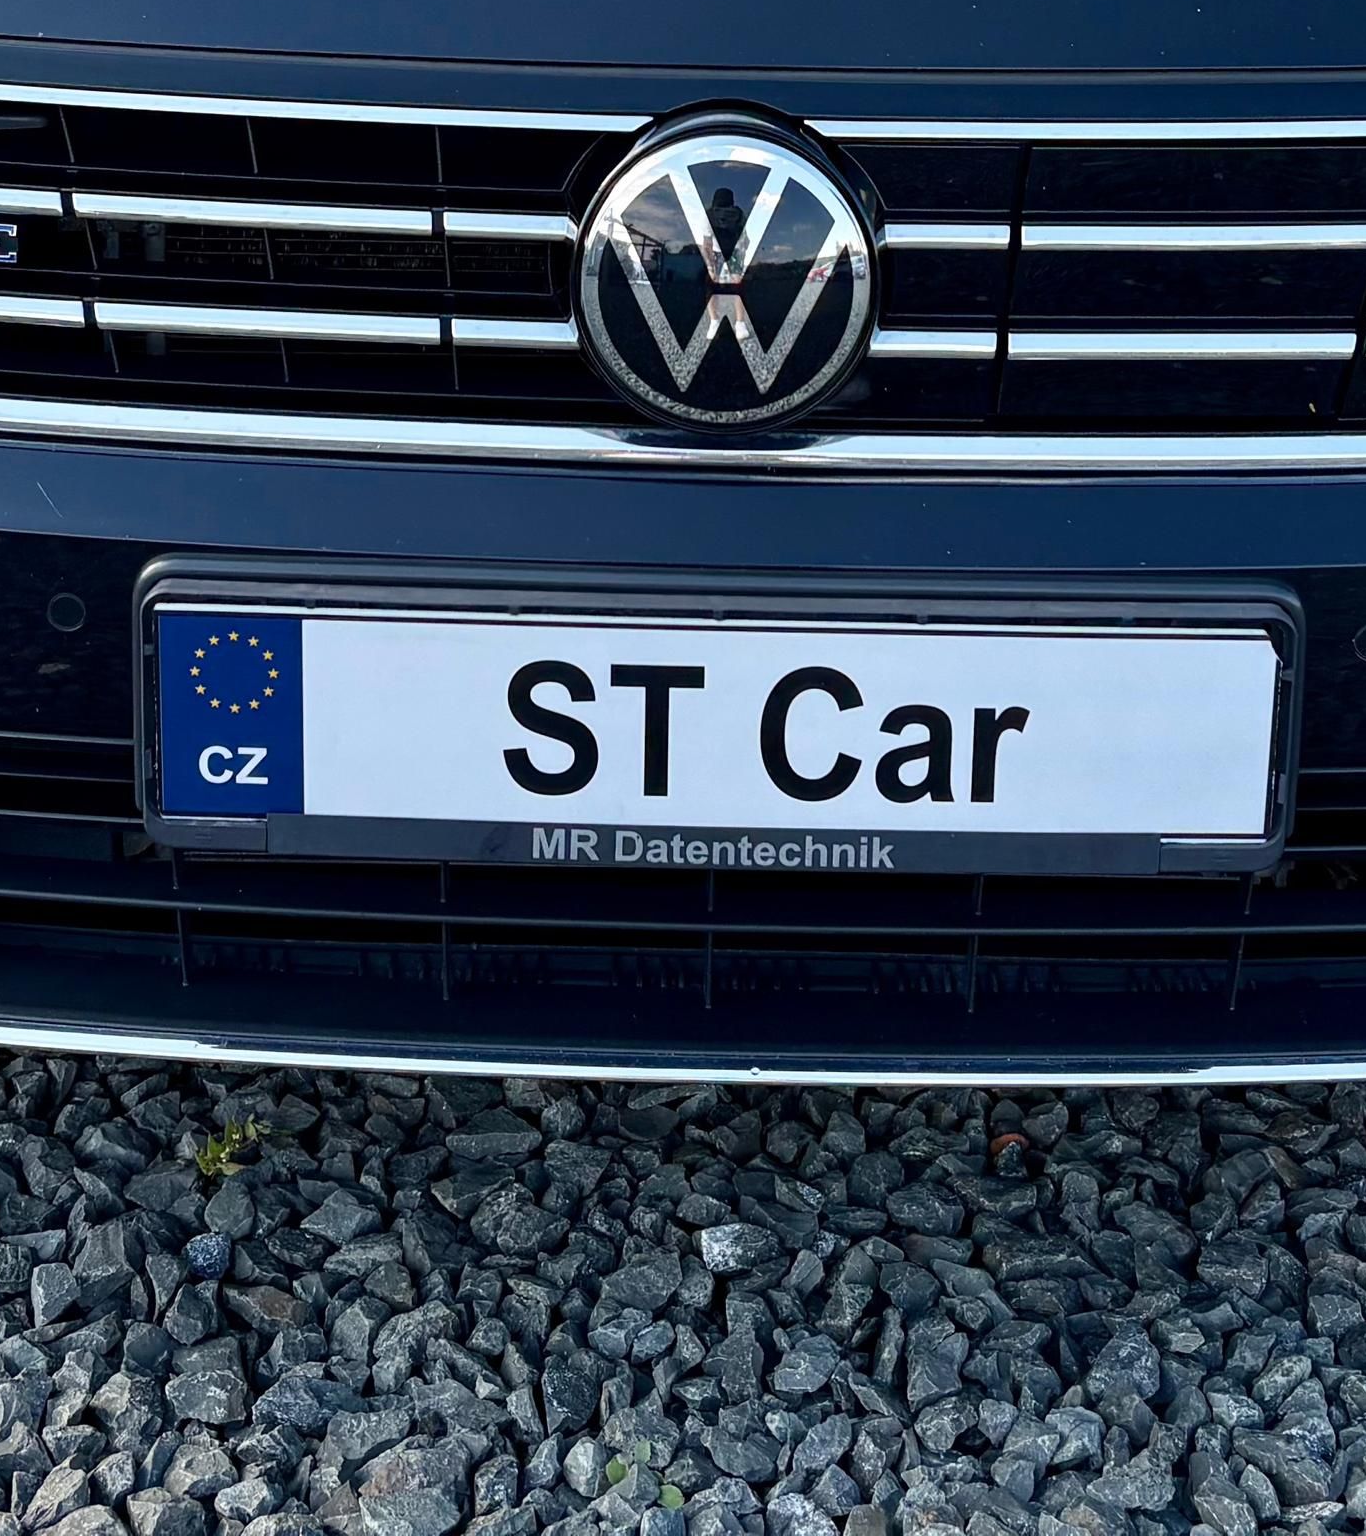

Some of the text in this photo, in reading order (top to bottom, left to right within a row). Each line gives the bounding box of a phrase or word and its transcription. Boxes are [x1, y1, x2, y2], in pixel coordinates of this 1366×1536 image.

[593, 150, 859, 402] VW
[198, 745, 269, 785] CZ
[502, 660, 1031, 803] ST Car
[531, 827, 895, 868] MR Datentechnik
